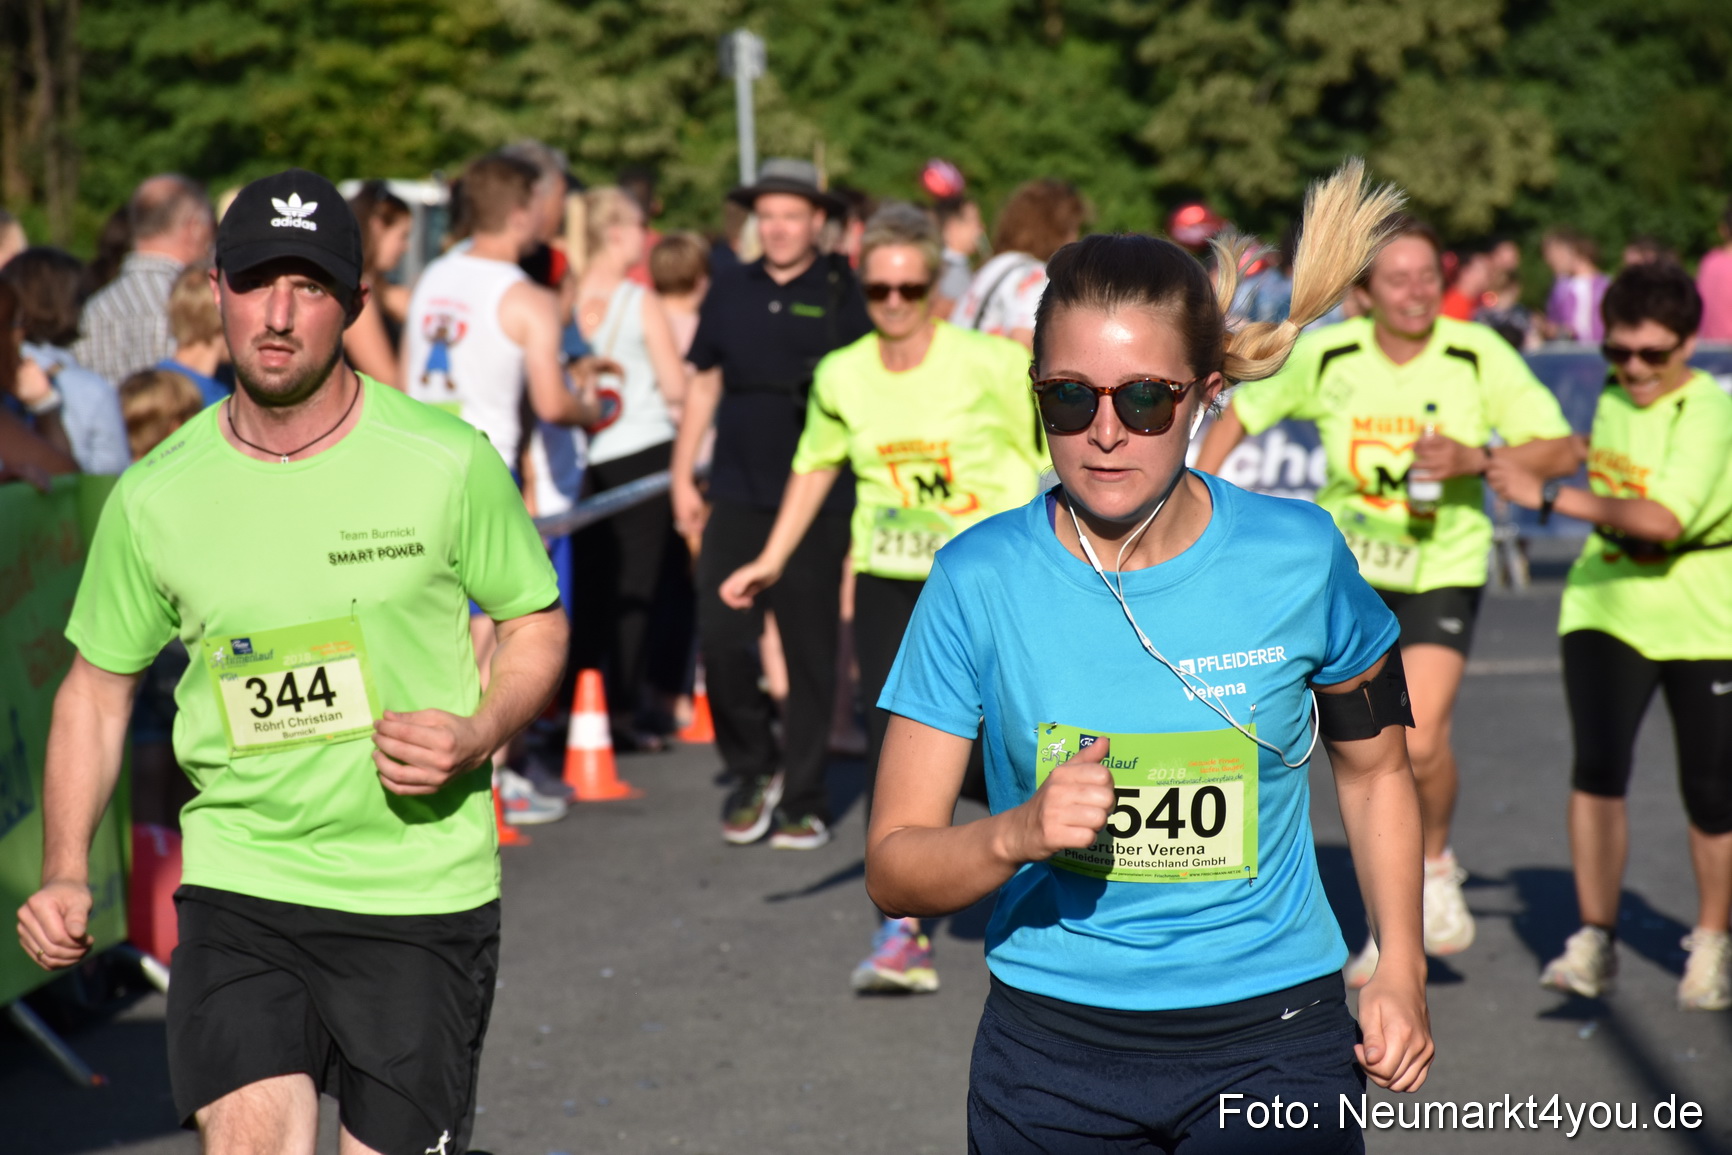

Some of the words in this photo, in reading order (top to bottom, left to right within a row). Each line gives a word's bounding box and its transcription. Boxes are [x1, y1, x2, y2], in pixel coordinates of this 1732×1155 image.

[270, 216, 317, 231] adidas
[1352, 416, 1441, 434] Müll
[914, 471, 951, 503] M
[339, 530, 368, 541] Team
[371, 526, 416, 540] Burnickl
[328, 547, 375, 566] SMART
[377, 541, 426, 561] POWER
[1197, 645, 1288, 673] PFLEIDERER
[245, 666, 337, 718] 344
[1183, 682, 1248, 702] Verena
[254, 718, 285, 732] Röhrl
[288, 710, 343, 728] Christian
[282, 727, 316, 740] Burnickl
[1065, 751, 1139, 769] fnlauf
[1147, 767, 1187, 780] 2018
[1064, 848, 1115, 867] Pfleiderer
[1118, 857, 1189, 868] Deutschland
[1192, 857, 1227, 867] GmbH
[1148, 842, 1205, 856] Verena
